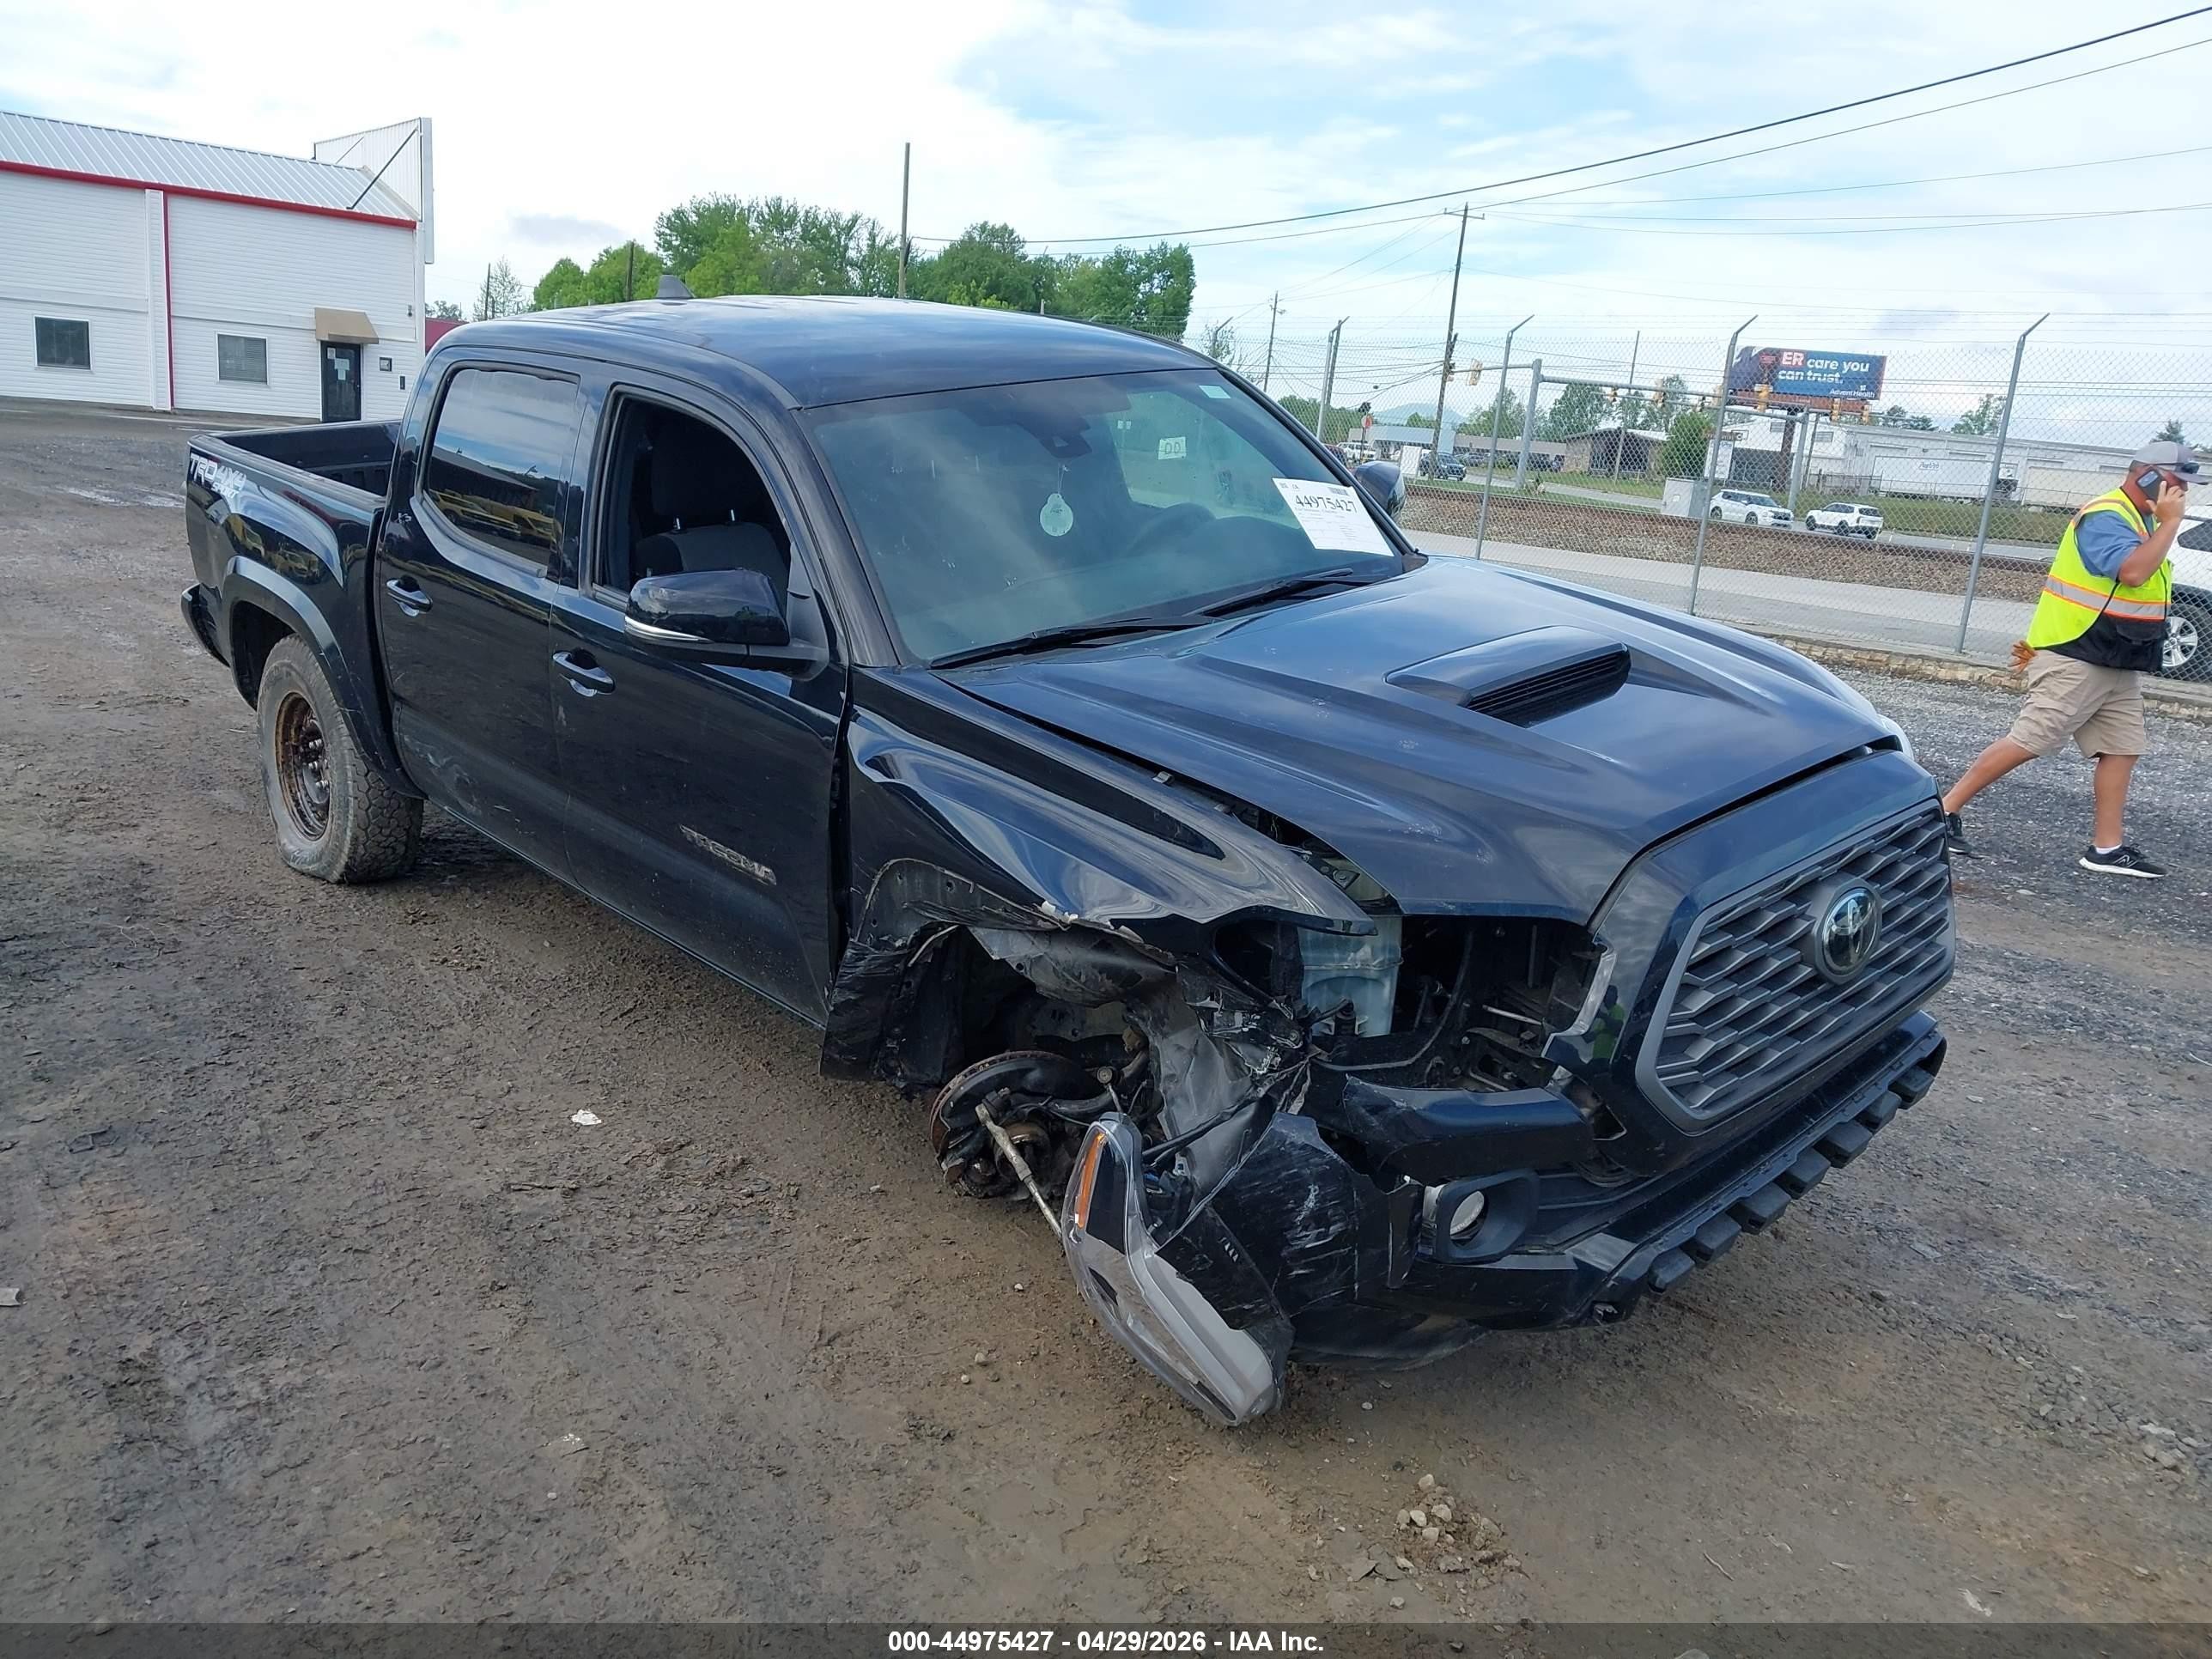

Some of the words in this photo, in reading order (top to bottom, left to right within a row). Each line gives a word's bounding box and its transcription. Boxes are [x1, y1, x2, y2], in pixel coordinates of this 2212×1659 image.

[1783, 352, 1805, 366] ER
[1807, 358, 1839, 370] care
[1842, 361, 1870, 374] you
[1778, 370, 1804, 380] can
[1807, 370, 1844, 385] trust.
[190, 453, 218, 484] TRD
[210, 482, 240, 499] SPORT
[1295, 495, 1358, 514] 44975427
